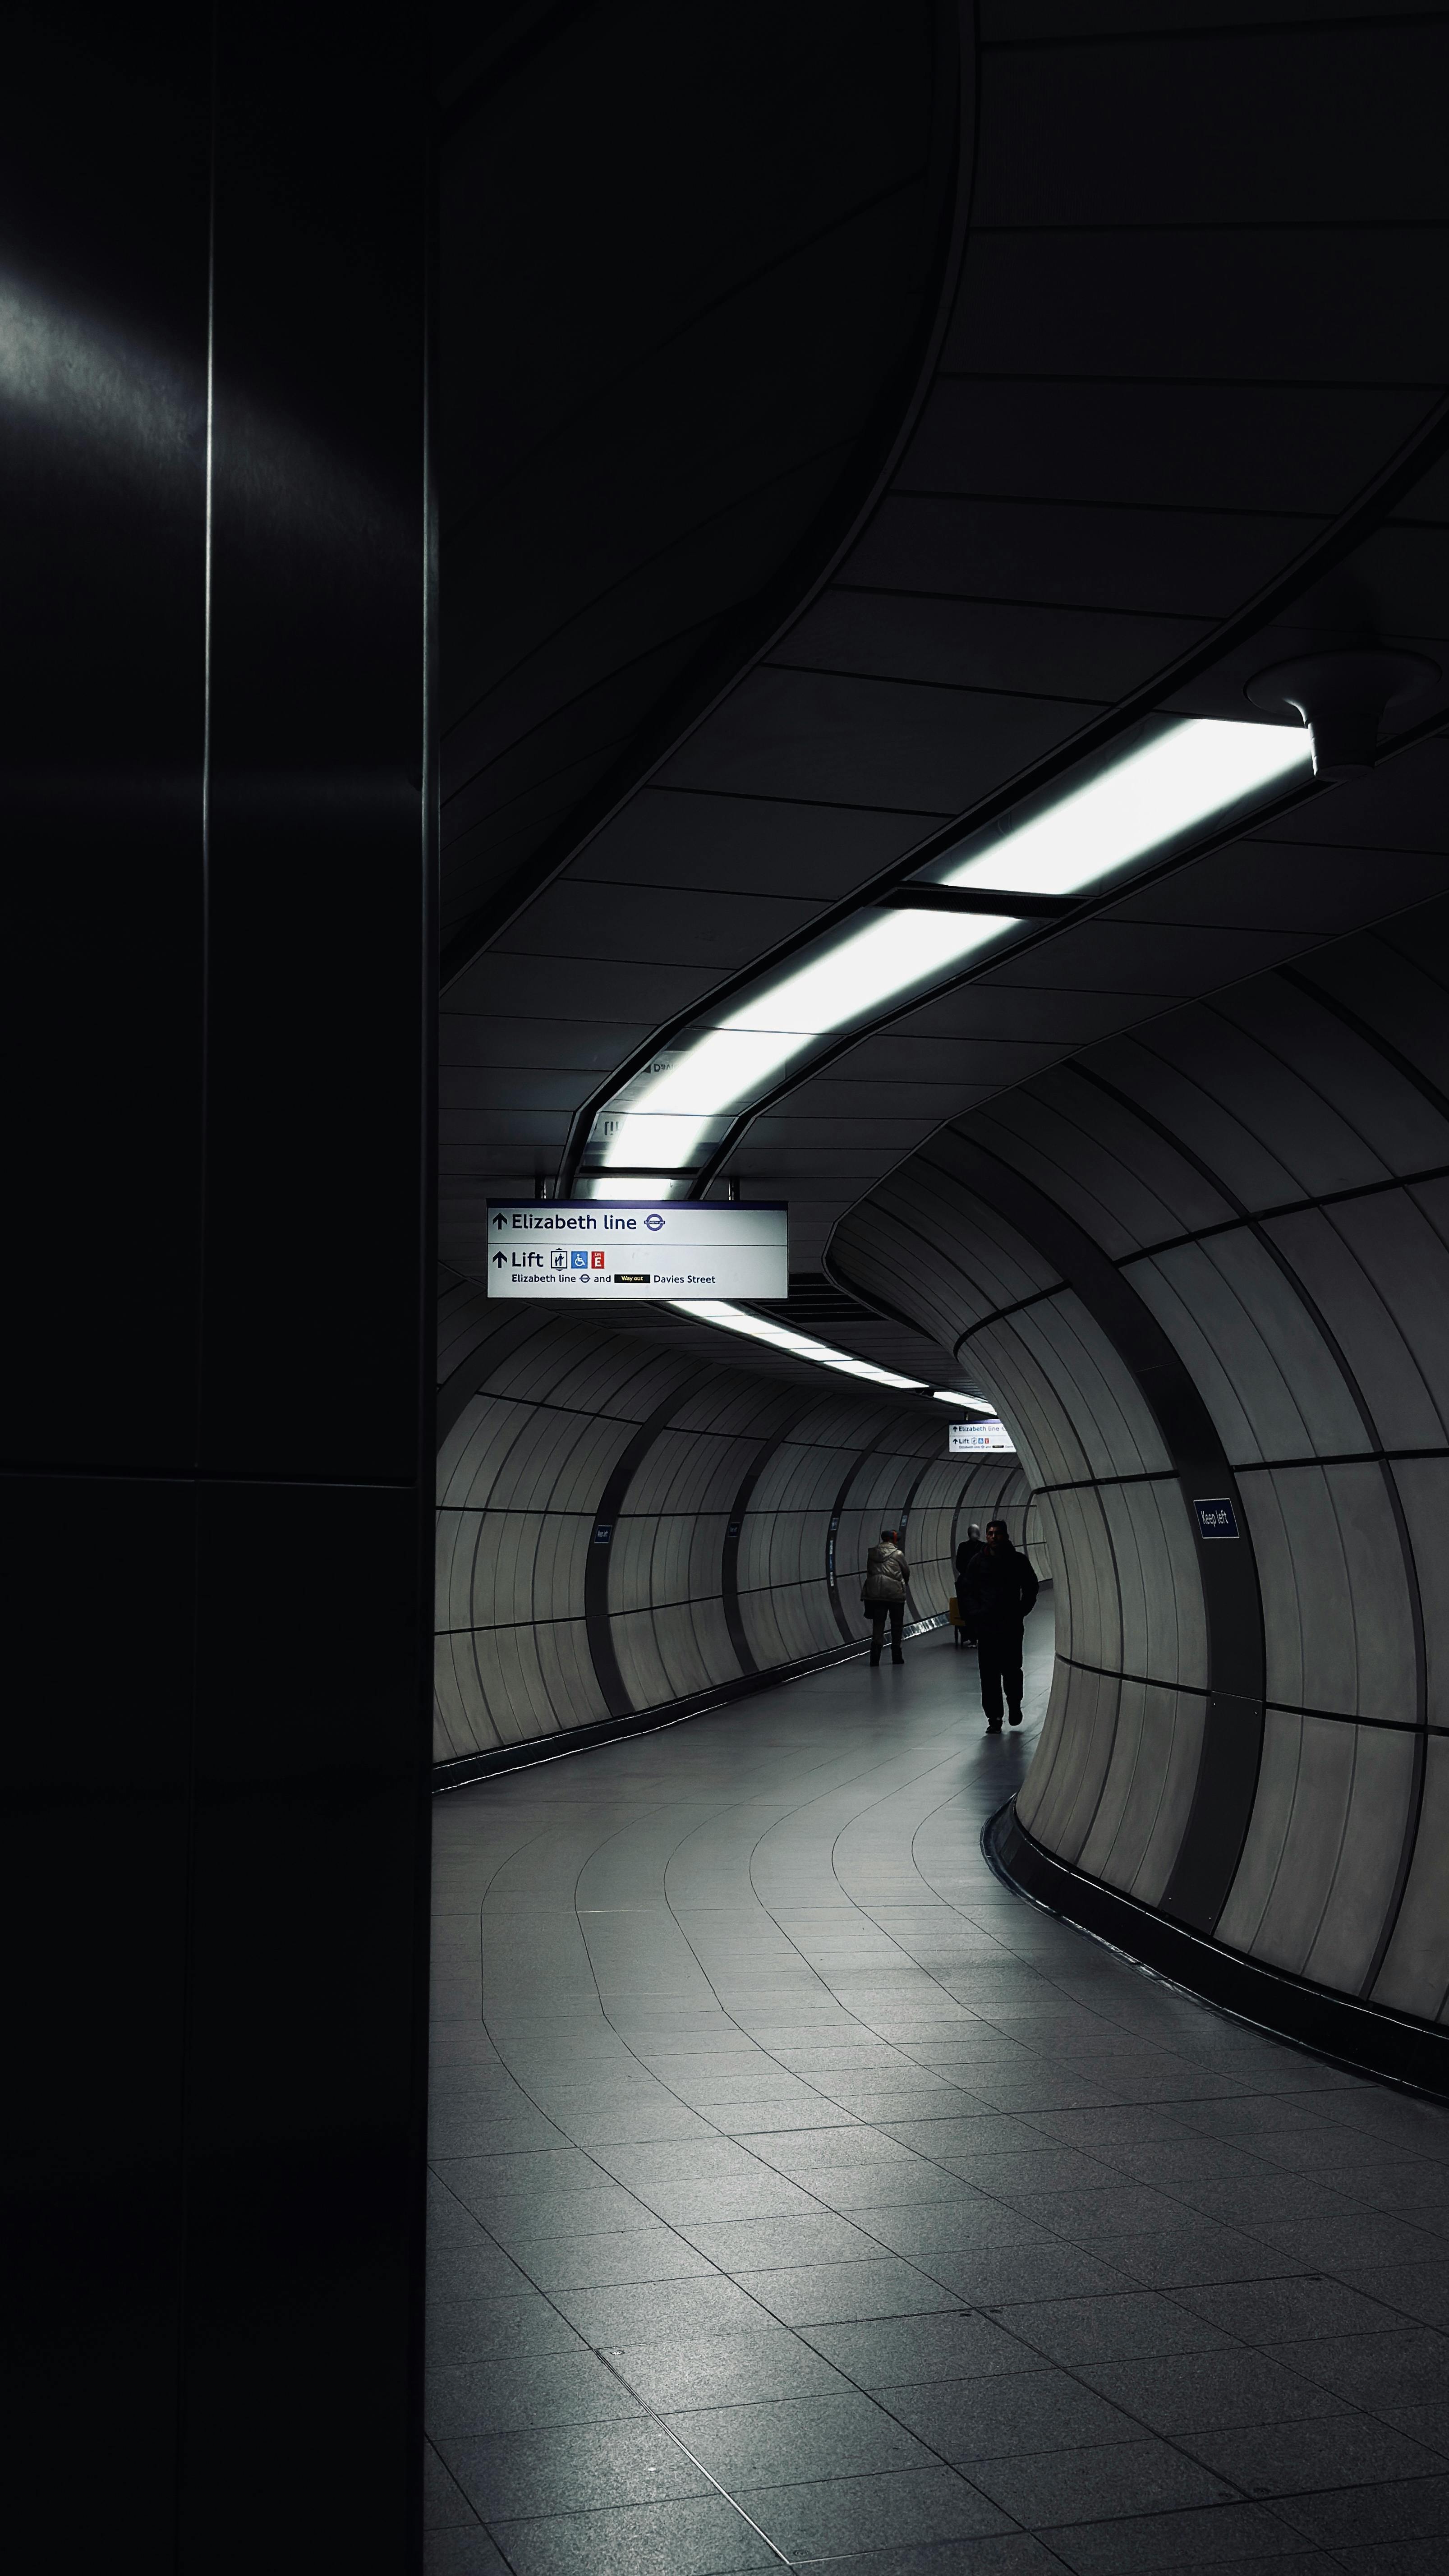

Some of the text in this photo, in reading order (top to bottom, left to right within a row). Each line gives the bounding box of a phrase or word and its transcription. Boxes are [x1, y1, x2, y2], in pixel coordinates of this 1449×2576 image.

[512, 1214, 637, 1229] Elizabeth line
[512, 1252, 544, 1267] Lift
[595, 1257, 602, 1267] E
[512, 1274, 556, 1283] Elizabeth
[559, 1274, 576, 1283] line
[653, 1275, 716, 1283] Davies Street
[1201, 1509, 1228, 1528] Keep left
